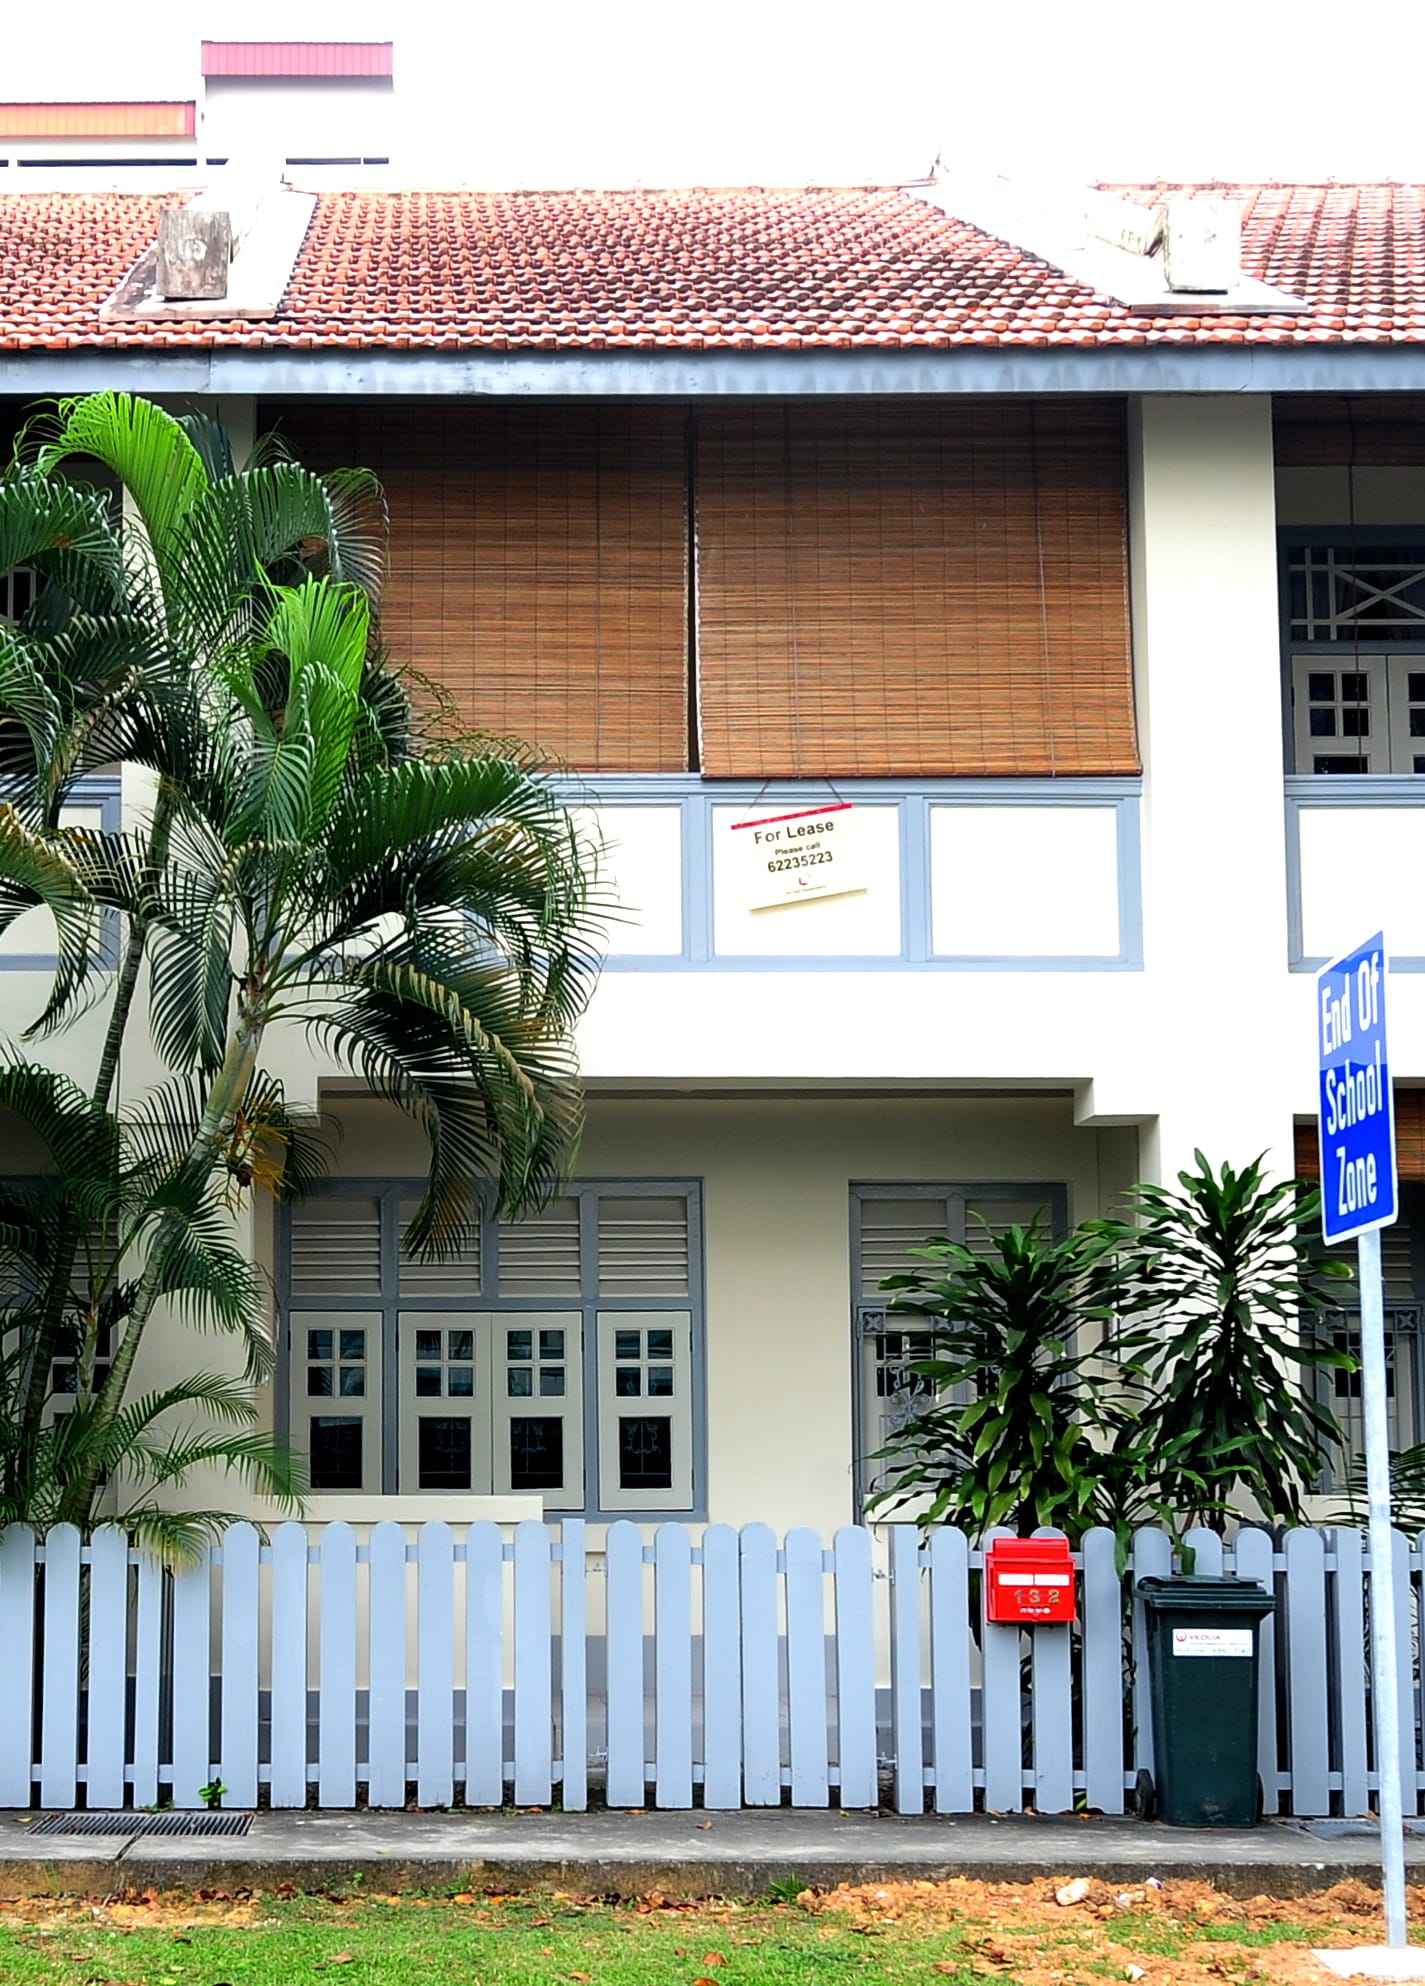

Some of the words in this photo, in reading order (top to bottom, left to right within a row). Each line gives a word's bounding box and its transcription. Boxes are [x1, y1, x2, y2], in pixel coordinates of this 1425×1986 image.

[754, 831, 781, 844] For
[786, 821, 834, 839] Lease
[775, 846, 803, 855] Please
[806, 842, 821, 851] call
[768, 851, 833, 872] 62235223
[1322, 972, 1352, 1056] End
[1358, 951, 1379, 1031] Of
[1326, 1040, 1382, 1136] School
[1336, 1146, 1377, 1216] Zone
